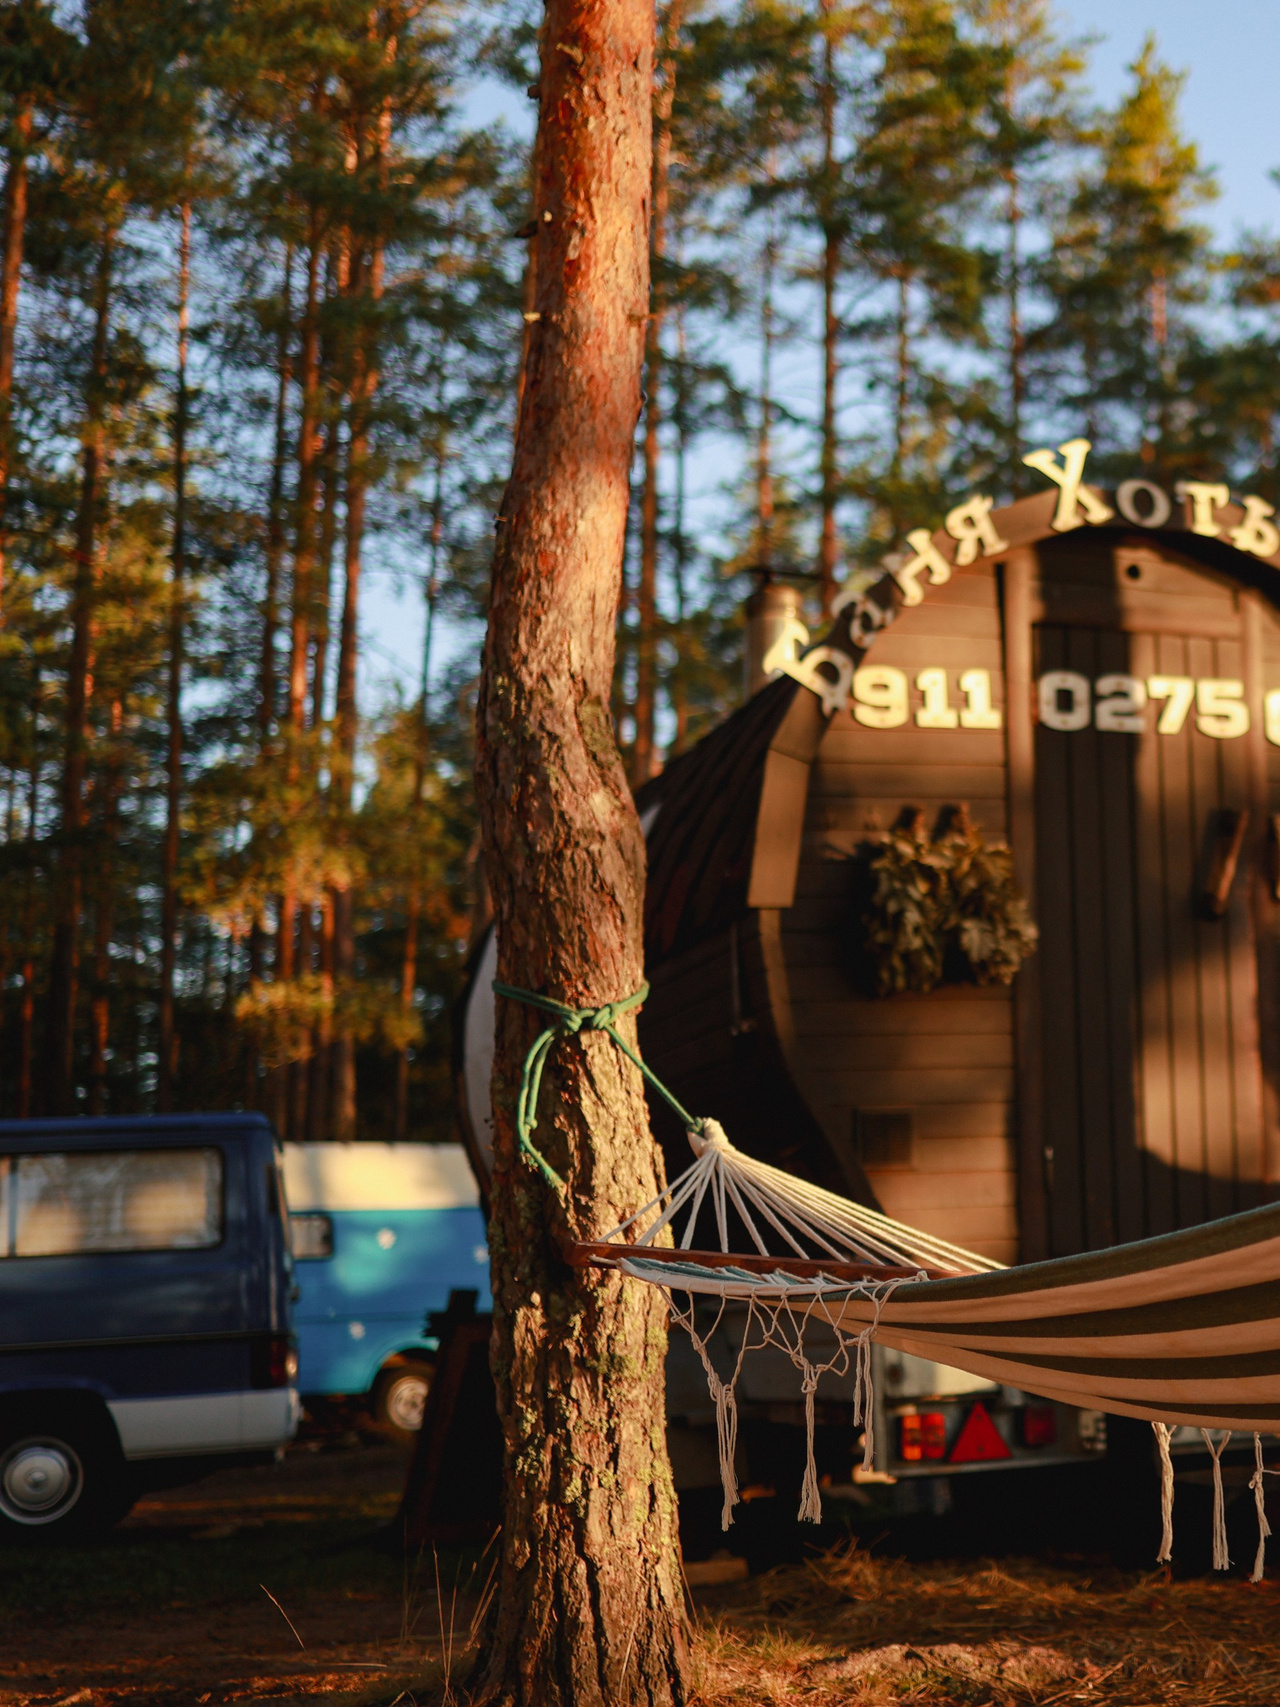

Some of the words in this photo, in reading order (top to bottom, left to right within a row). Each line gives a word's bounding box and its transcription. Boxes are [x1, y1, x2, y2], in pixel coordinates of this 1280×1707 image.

[1022, 438, 1279, 557] Хоть
[853, 665, 1002, 729] 911
[1038, 671, 1250, 739] 0275
